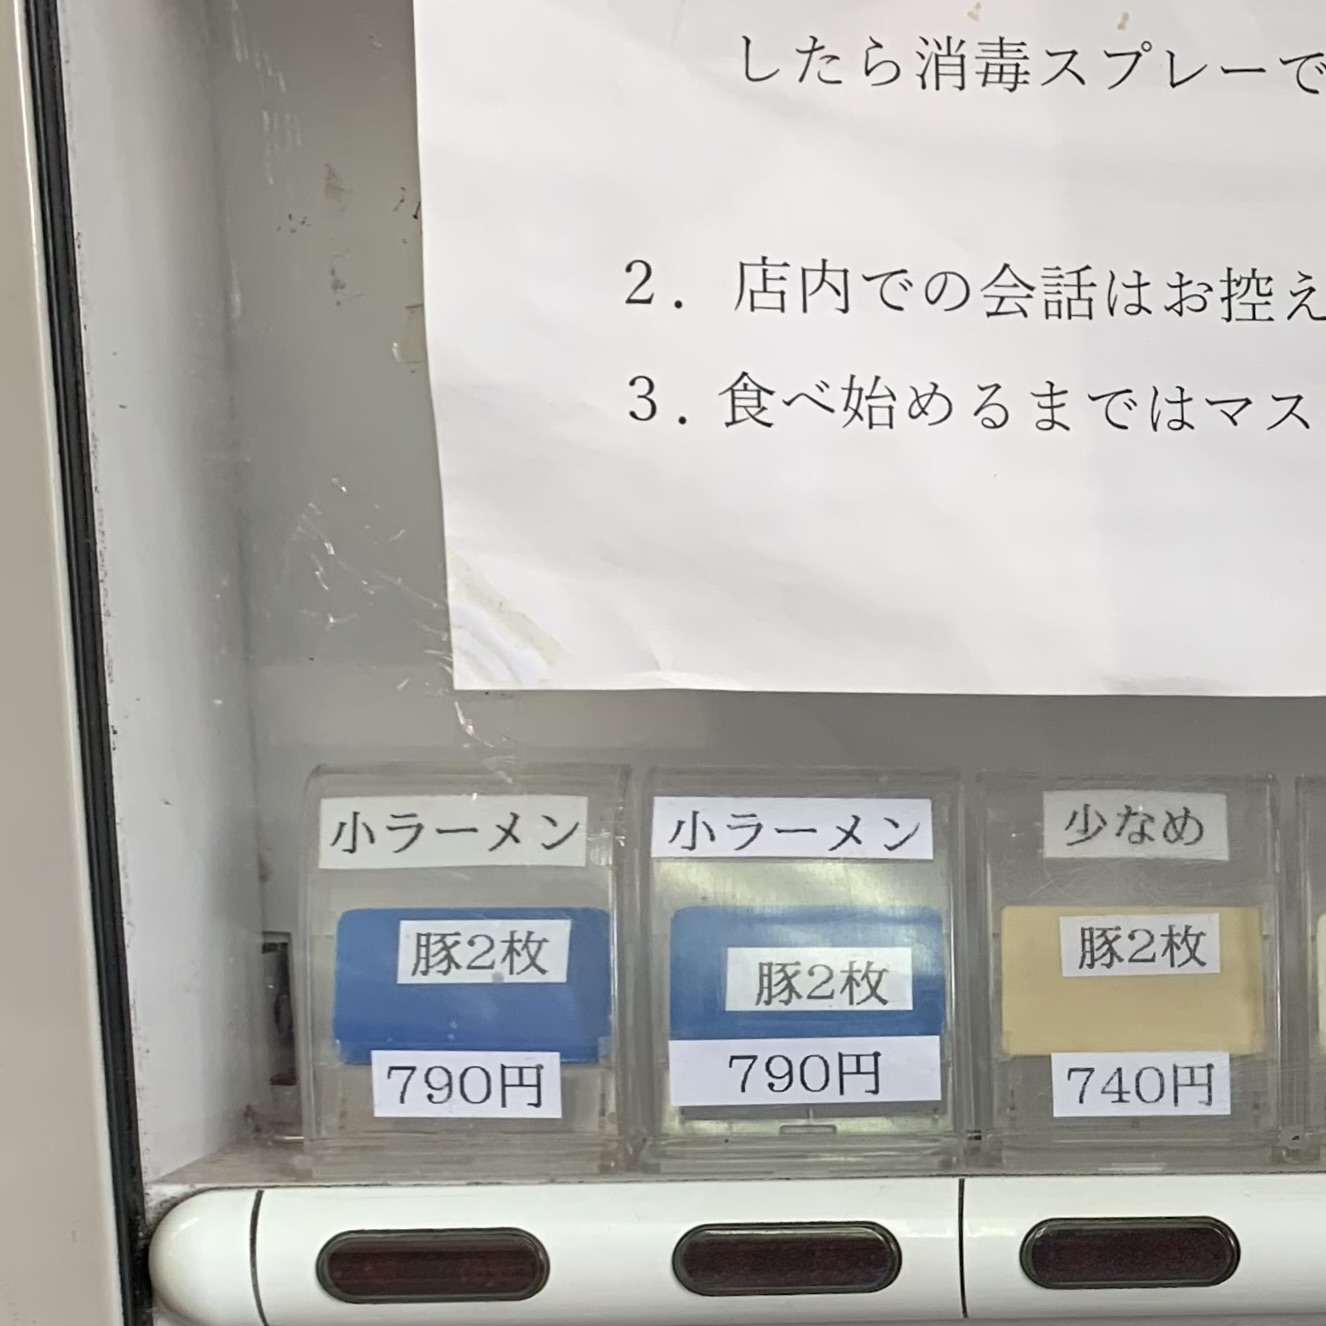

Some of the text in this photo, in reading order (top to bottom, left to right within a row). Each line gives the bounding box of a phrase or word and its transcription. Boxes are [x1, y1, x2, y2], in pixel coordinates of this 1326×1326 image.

[331, 811, 579, 854] 小ラーメン
[669, 810, 919, 851] 小ラーメン
[1065, 805, 1204, 846] 少なめ
[411, 930, 549, 976] 豚2枚
[1079, 925, 1207, 969] 豚2枚
[755, 961, 888, 1006] 豚2枚
[387, 1064, 544, 1108] 790円
[729, 1051, 881, 1095] 790円
[1067, 1063, 1214, 1107] 740円
